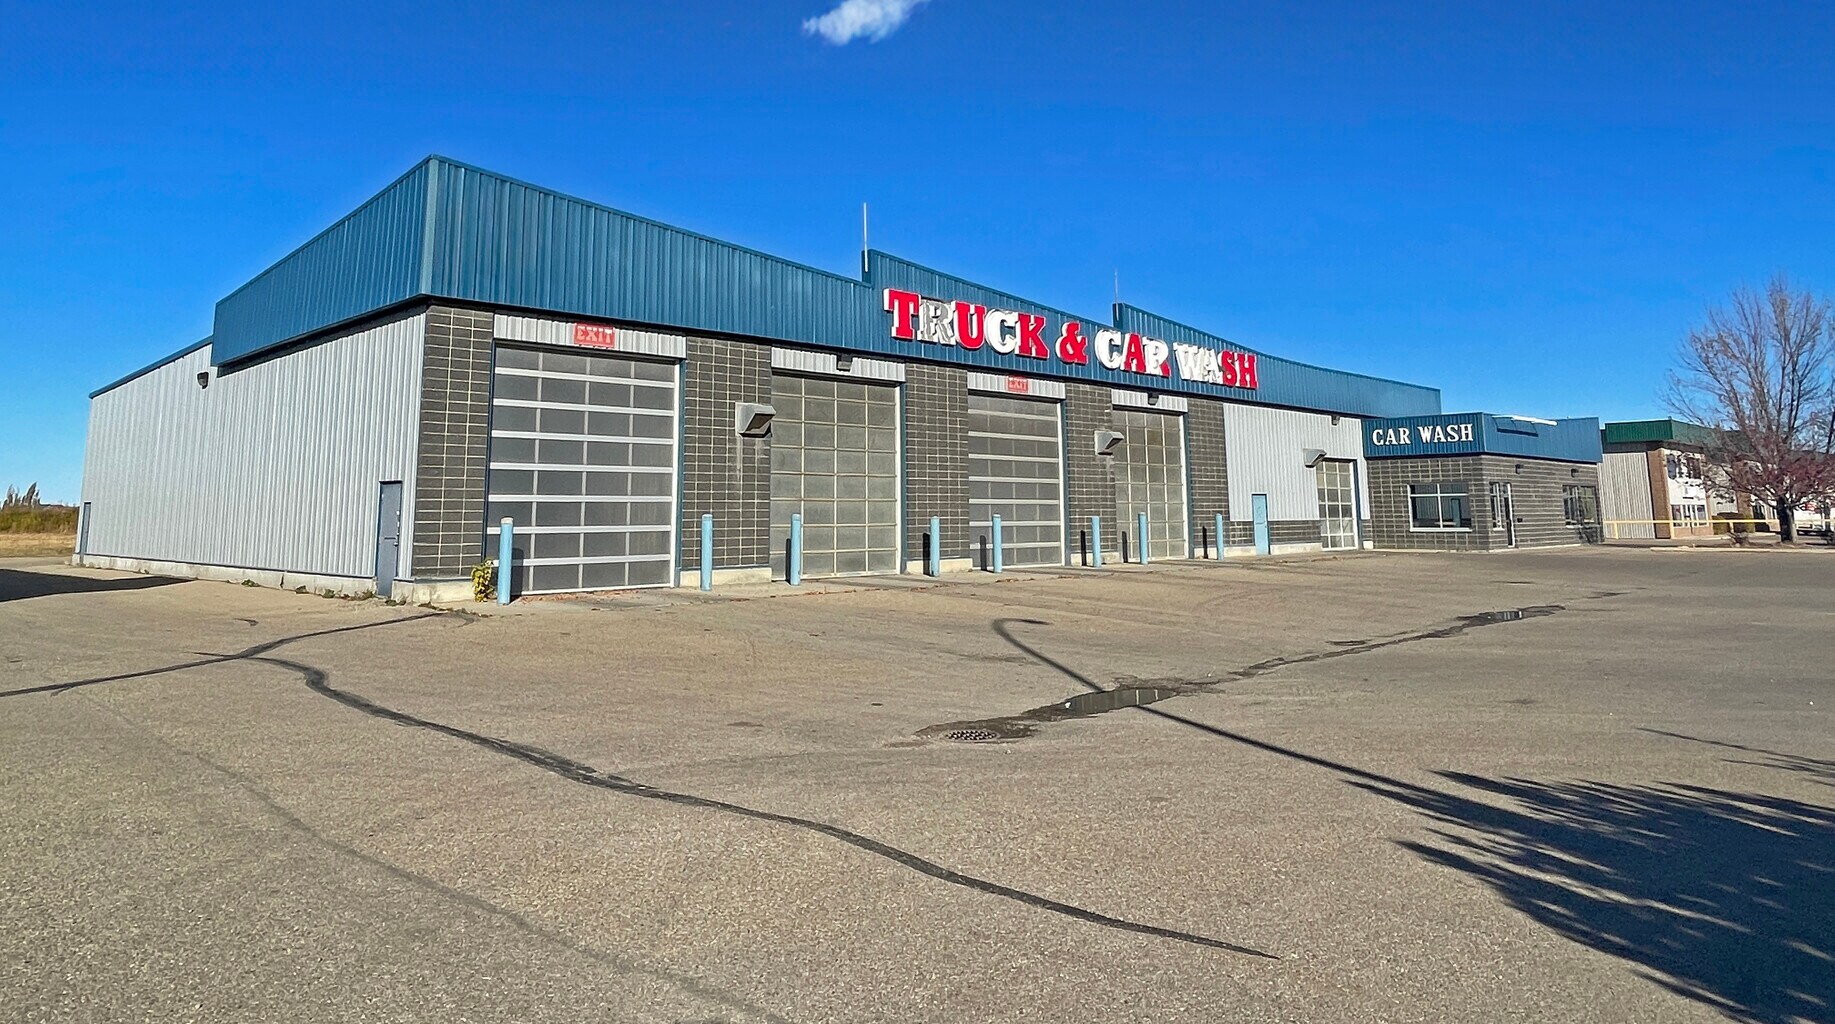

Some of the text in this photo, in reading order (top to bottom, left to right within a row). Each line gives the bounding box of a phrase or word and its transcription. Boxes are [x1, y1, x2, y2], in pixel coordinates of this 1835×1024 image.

[576, 325, 613, 344] EXIT
[884, 288, 1257, 389] TRUCK & CAR WASH
[1372, 423, 1474, 446] CAR WASH
